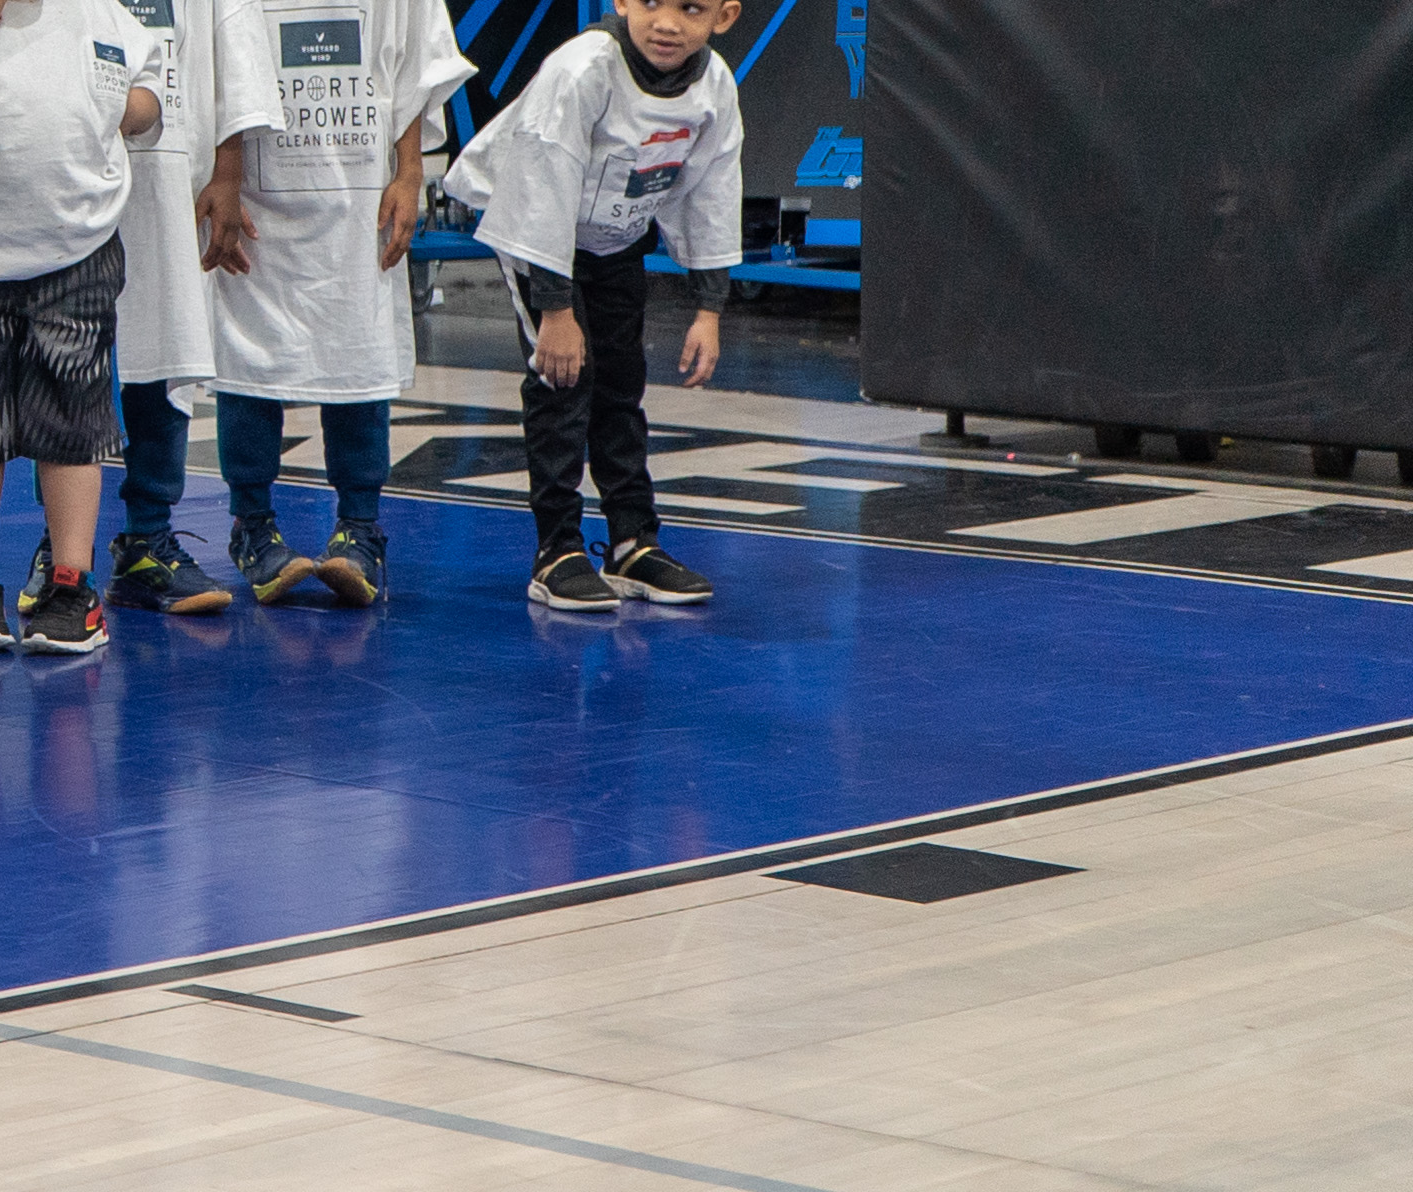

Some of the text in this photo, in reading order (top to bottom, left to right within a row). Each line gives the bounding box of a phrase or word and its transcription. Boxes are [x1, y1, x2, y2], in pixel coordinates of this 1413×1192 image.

[299, 106, 376, 128] POWER
[276, 132, 377, 147] CLEAN ENERGY
